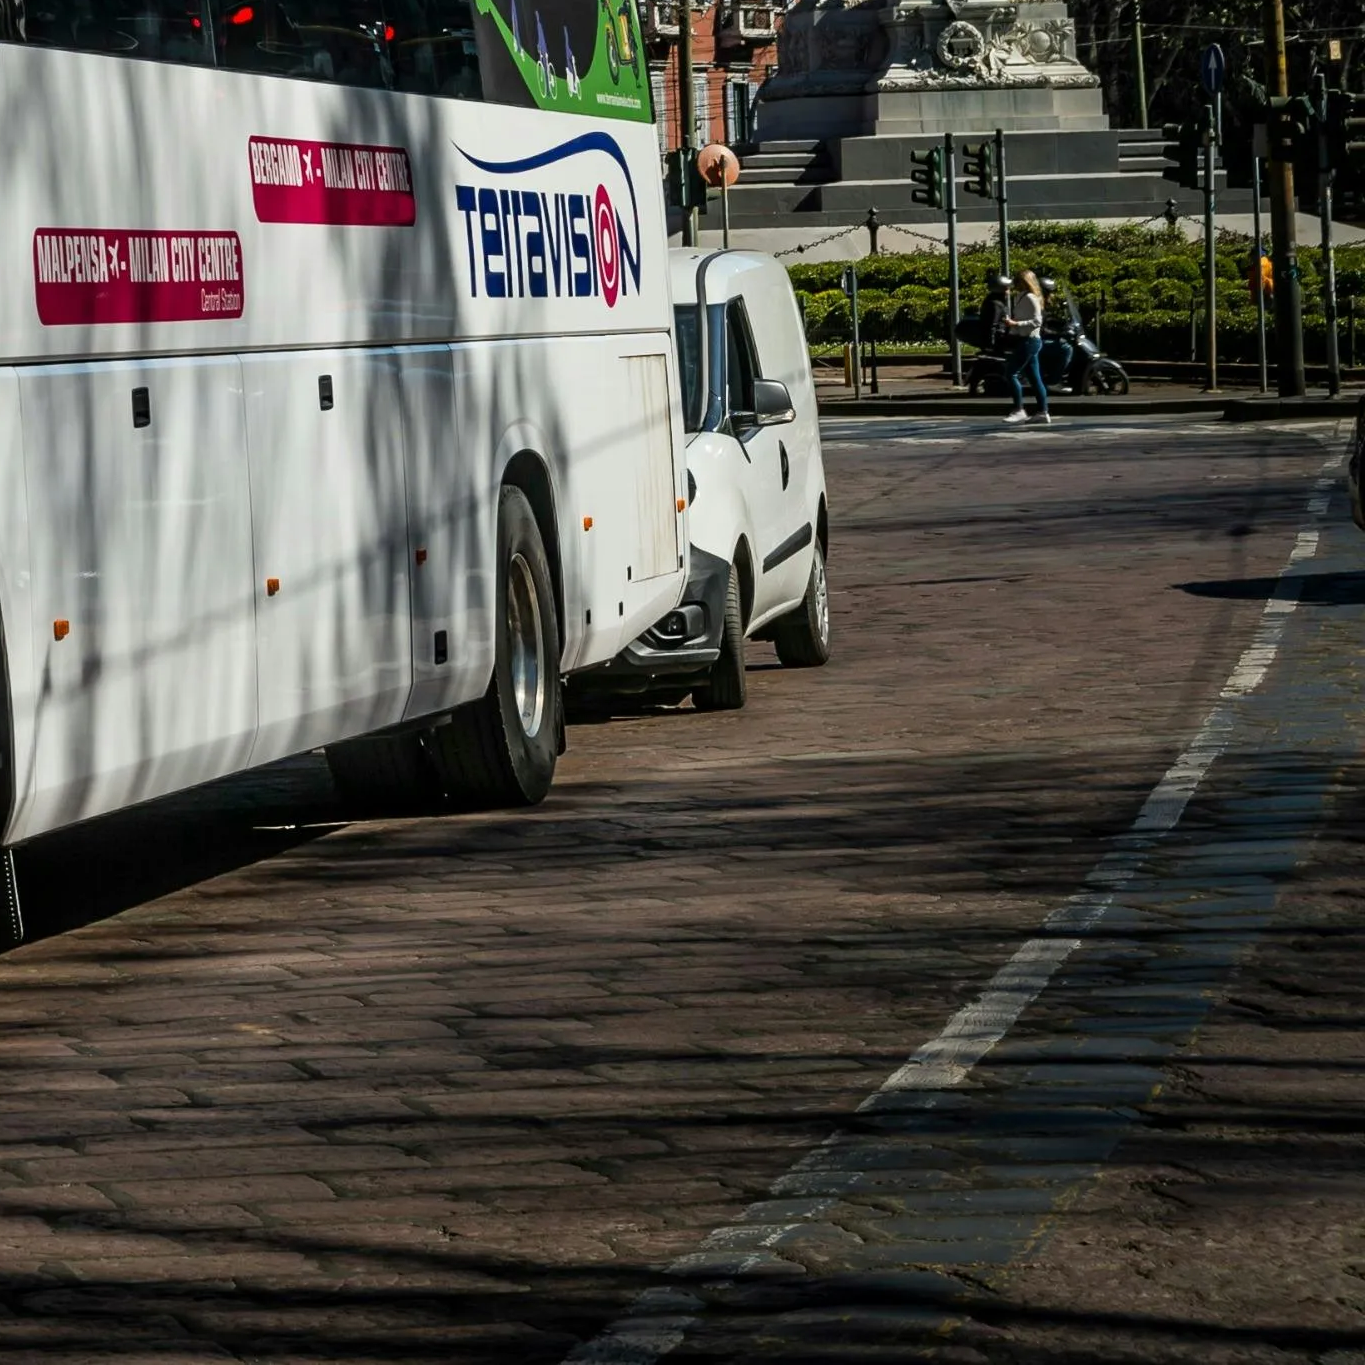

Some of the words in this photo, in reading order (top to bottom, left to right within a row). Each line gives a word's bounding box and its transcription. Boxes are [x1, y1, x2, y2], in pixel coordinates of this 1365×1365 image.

[250, 141, 303, 187] BERGAMO
[321, 147, 356, 189] MILAN
[354, 150, 376, 190] CITY
[375, 151, 411, 192] CENTRE
[36, 235, 109, 283] MALPENSA
[128, 237, 170, 283] MILAN
[170, 237, 195, 283] CITY
[197, 237, 240, 283] CENTRE
[201, 287, 221, 312] Central
[221, 286, 241, 311] Station
